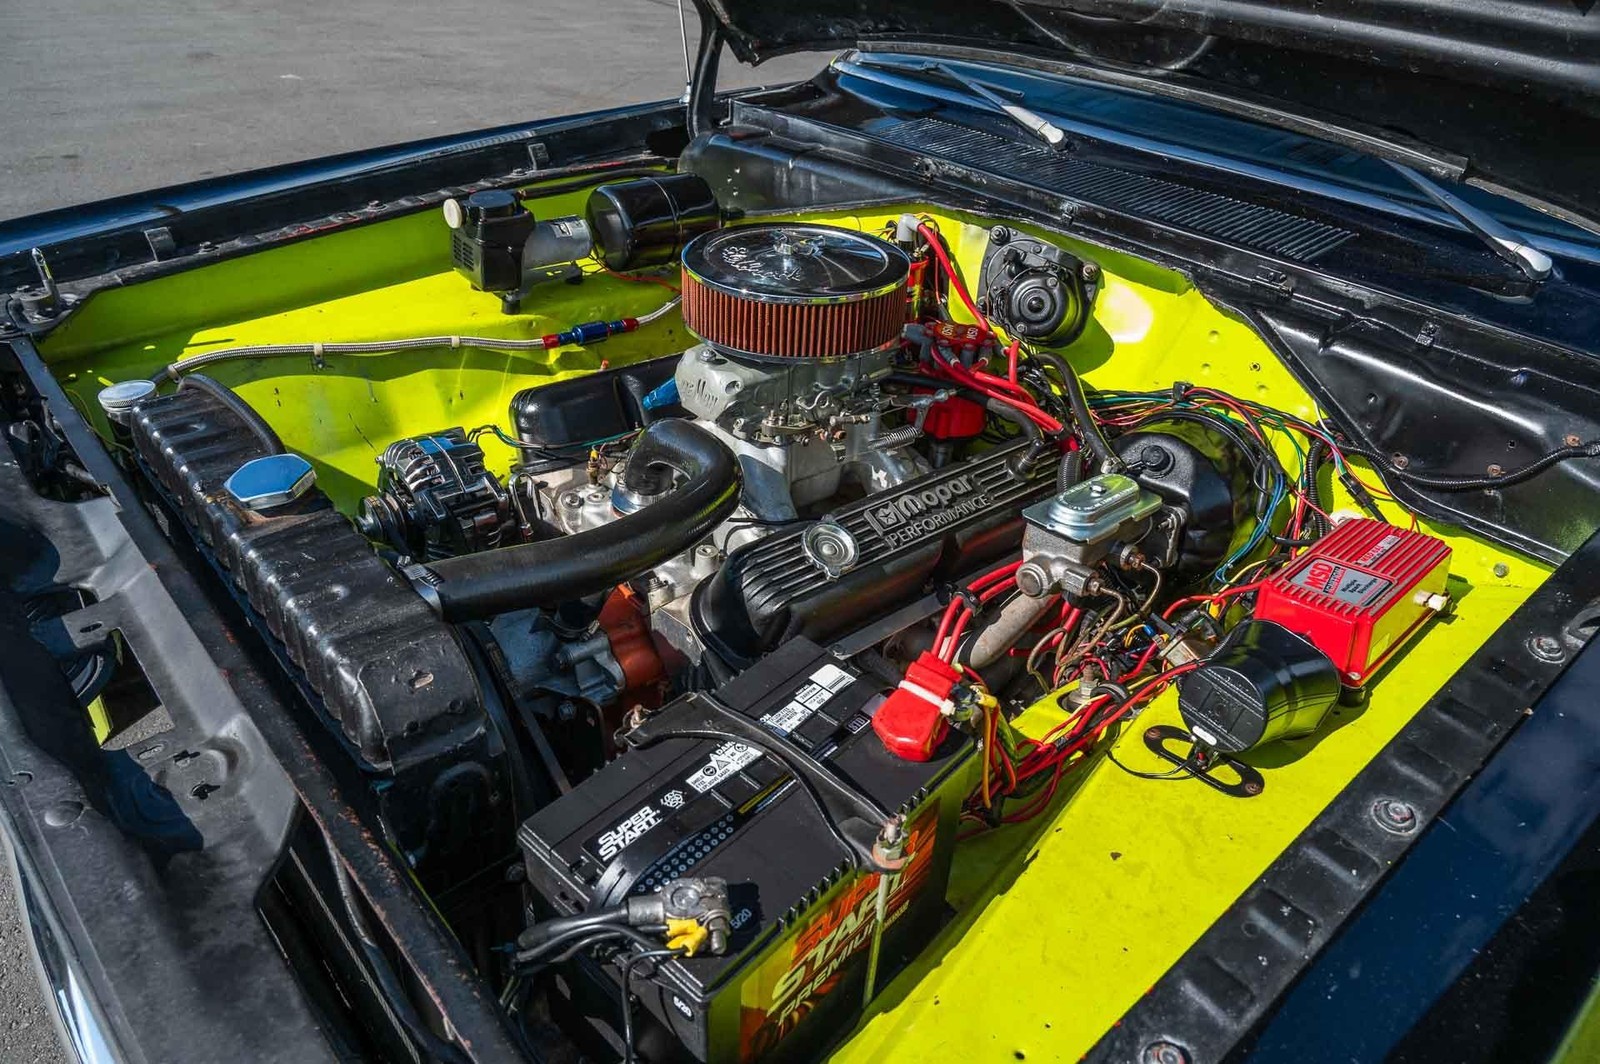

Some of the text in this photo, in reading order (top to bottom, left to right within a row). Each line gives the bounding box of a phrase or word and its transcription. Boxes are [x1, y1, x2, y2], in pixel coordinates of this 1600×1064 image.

[895, 474, 973, 518] Mopar
[887, 494, 992, 548] PERFORMANCE
[1303, 562, 1333, 591] MSD
[598, 806, 653, 846] SUPER
[598, 810, 657, 862] START
